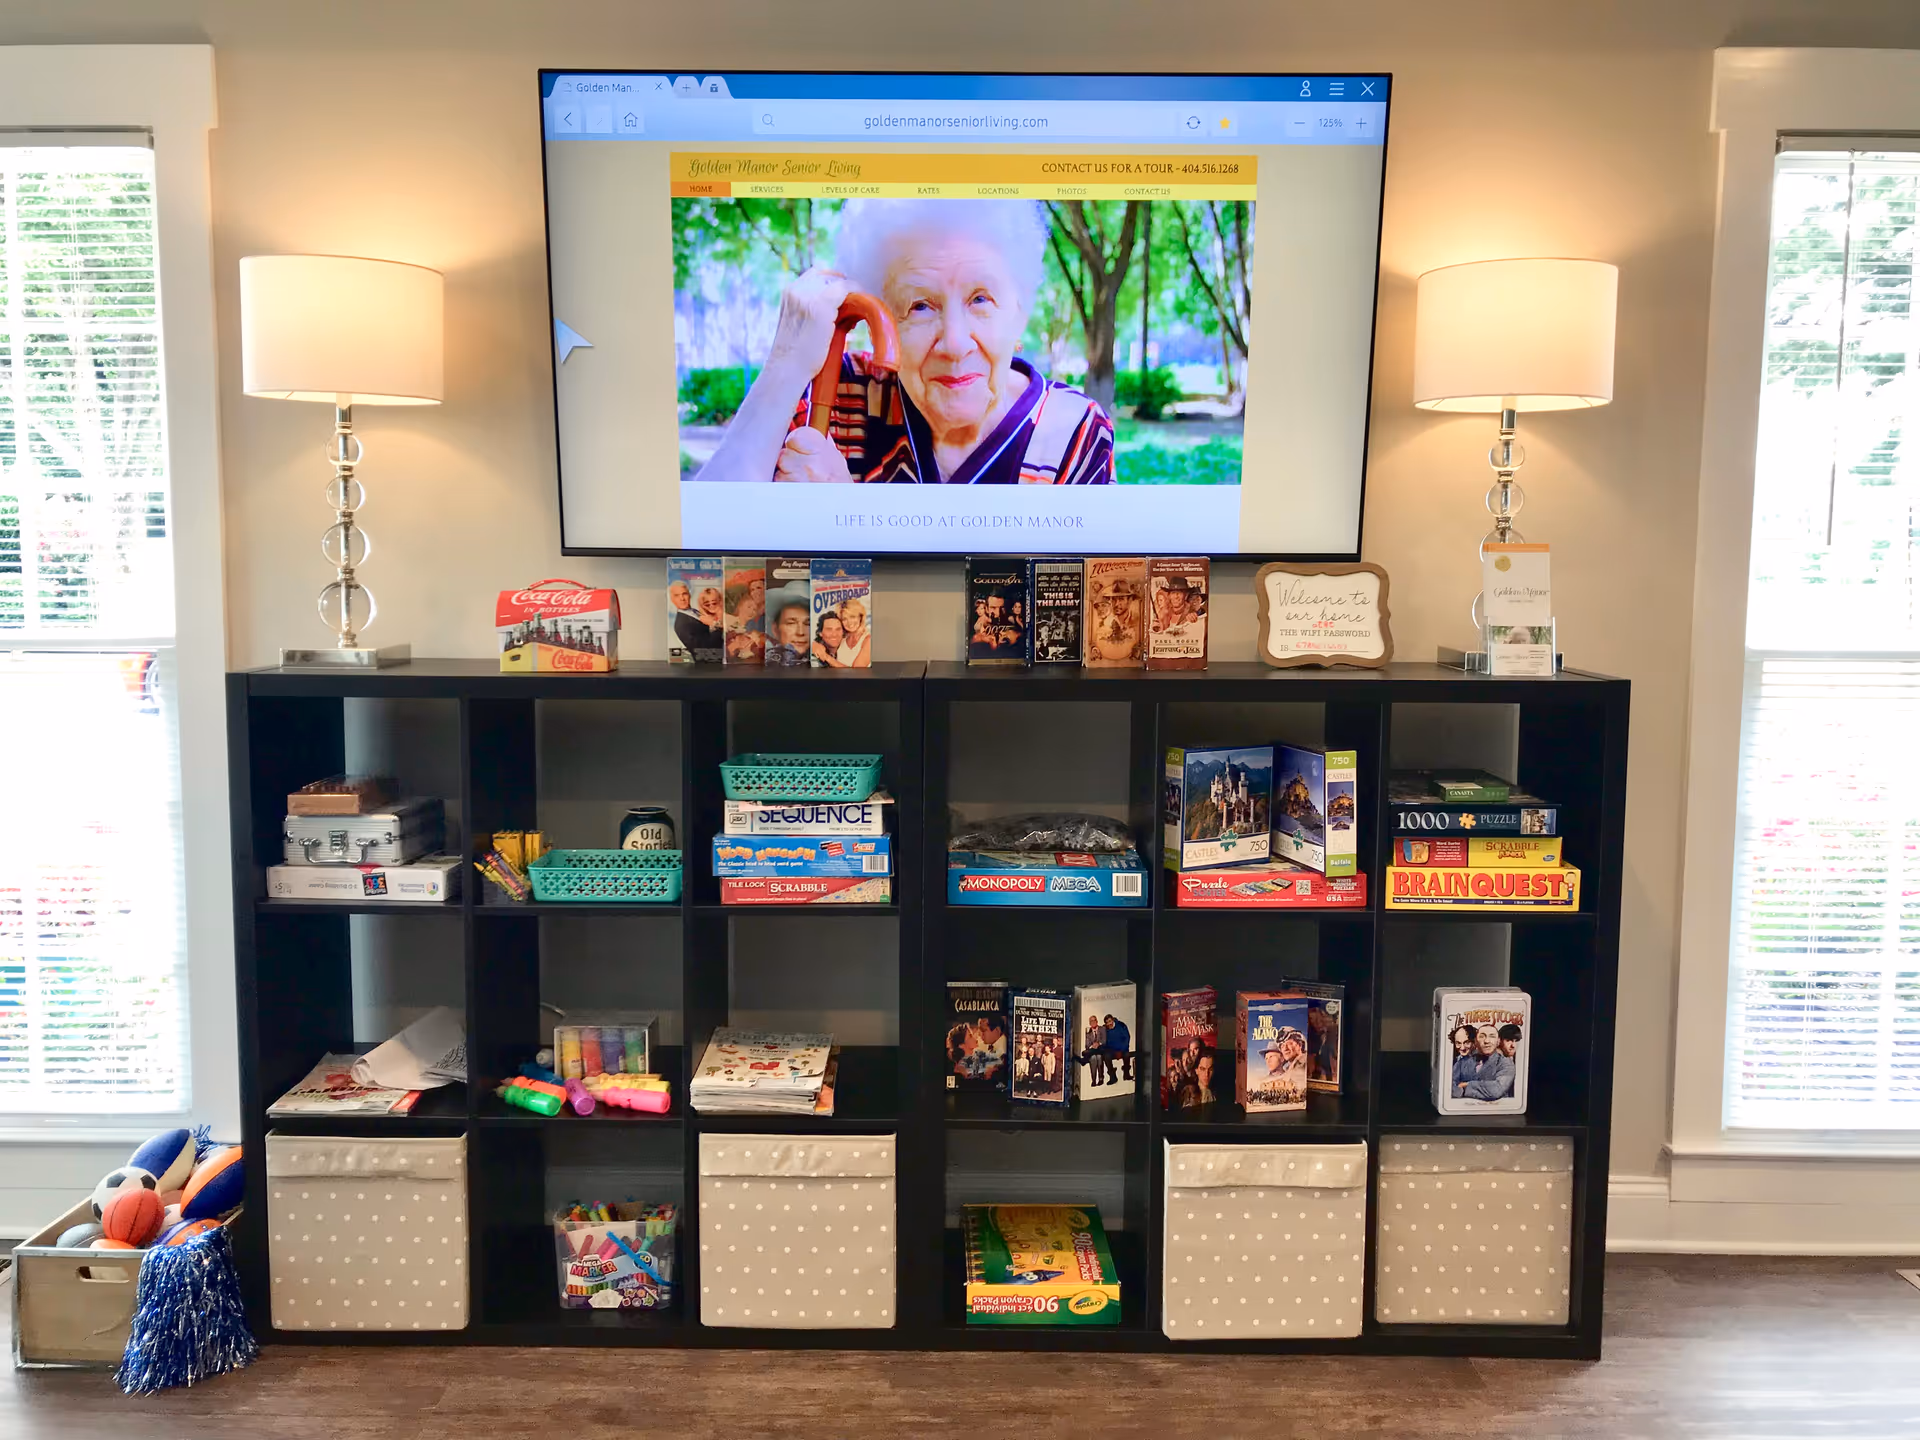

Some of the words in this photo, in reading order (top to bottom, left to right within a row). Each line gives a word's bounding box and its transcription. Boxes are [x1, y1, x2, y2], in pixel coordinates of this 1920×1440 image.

[576, 82, 610, 94] Golden
[864, 115, 1049, 131] goldenmanorseniorliving.com
[1318, 117, 1343, 128] 125%
[688, 158, 731, 178] Golden
[735, 159, 778, 175] Manor
[782, 159, 821, 176] Senior
[824, 160, 861, 178] Living
[1041, 162, 1092, 174] CONTACT
[1094, 163, 1108, 174] US
[1111, 163, 1132, 174] FOR
[1134, 163, 1143, 174] A
[1144, 163, 1174, 174] TOUR
[1181, 163, 1239, 175] 404.516.1268
[689, 185, 713, 193] HOME
[821, 186, 848, 194] LEVELS
[848, 186, 859, 194] OF
[860, 186, 880, 194] CARE
[917, 186, 941, 194] RATES
[977, 187, 1020, 195] LOCATIONS
[1056, 187, 1087, 195] PHOTOS
[835, 514, 866, 527] LIFE
[871, 515, 883, 527] IS
[888, 515, 933, 528] GOOD
[938, 515, 957, 528] AT
[961, 515, 1023, 528] GOLDEN
[1028, 516, 1085, 529] MANOR
[1275, 579, 1347, 607] Welcome
[1349, 590, 1371, 606] to
[813, 587, 870, 614] OVERBOARD
[1054, 599, 1080, 607] ARMY
[1285, 612, 1314, 621] our
[1319, 606, 1365, 622] home
[1300, 629, 1321, 637] WIFI
[1323, 630, 1371, 638] PASSWORD
[1332, 757, 1350, 765] 750
[1327, 772, 1353, 780] CASTLES
[758, 804, 872, 823] SEQUENCE
[1397, 811, 1450, 830] 1000
[1480, 814, 1518, 824] PUZZLE
[640, 828, 662, 840] Old
[1249, 839, 1268, 852] 750
[1485, 842, 1540, 851] SCRABBLE
[1185, 847, 1219, 860] CASTLES
[1311, 849, 1324, 864] 750
[1498, 850, 1527, 859] JUNIOR
[1330, 858, 1352, 867] Buffalo
[770, 883, 828, 893] SCRABBLE
[967, 877, 1042, 890] MONOPOLY
[1050, 876, 1101, 893] MEGA
[1182, 876, 1230, 892] Puzzle
[1392, 871, 1470, 897] BRAIN
[1470, 872, 1564, 898] QUEST
[1193, 888, 1227, 897] SORTER
[955, 998, 1000, 1012] CASABLANCA
[1021, 1015, 1038, 1025] LIFE
[1038, 1017, 1058, 1026] WITH
[1176, 1015, 1196, 1028] MAN
[1258, 1015, 1273, 1025] THE
[1447, 1013, 1465, 1029] The
[1464, 1009, 1491, 1024] THREE
[1021, 1023, 1058, 1034] FATHER
[1190, 1023, 1214, 1037] MASK
[1252, 1027, 1279, 1041] ALAMO
[1075, 1245, 1089, 1264] Crayon
[570, 1261, 618, 1277] MARKER
[1080, 1263, 1092, 1280] Packs
[1088, 1254, 1105, 1281] Individual
[973, 1296, 997, 1305] Packs
[997, 1294, 1034, 1305] Crayon
[1033, 1296, 1059, 1313] 90
[1075, 1300, 1103, 1310] Crayola
[973, 1304, 1016, 1314] Individual
[1019, 1304, 1033, 1313] 4ct
